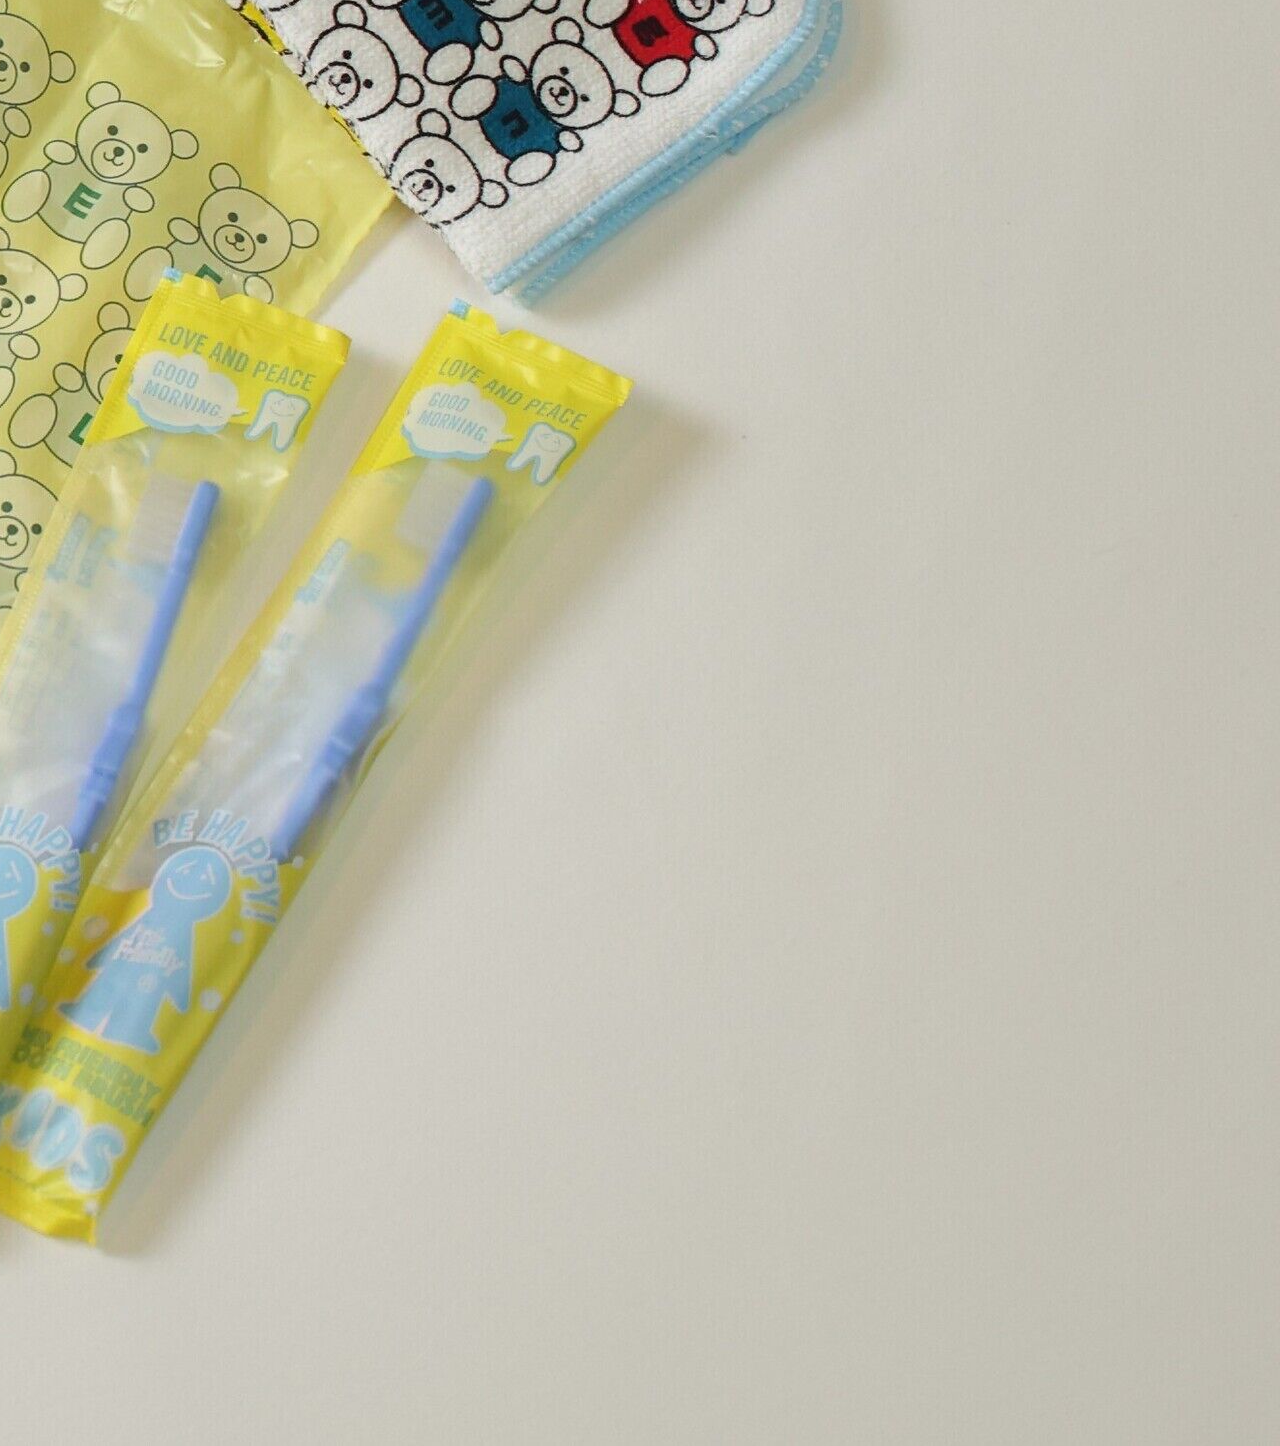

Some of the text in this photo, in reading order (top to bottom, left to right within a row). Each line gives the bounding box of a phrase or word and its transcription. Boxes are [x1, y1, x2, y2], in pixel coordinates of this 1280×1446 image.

[63, 183, 102, 220] E
[152, 359, 200, 390] GOOD
[157, 322, 317, 392] LOVE AND PEACE
[427, 391, 471, 413] GOOD
[438, 357, 588, 431] LOVE AND PEACE
[153, 809, 199, 849] BE
